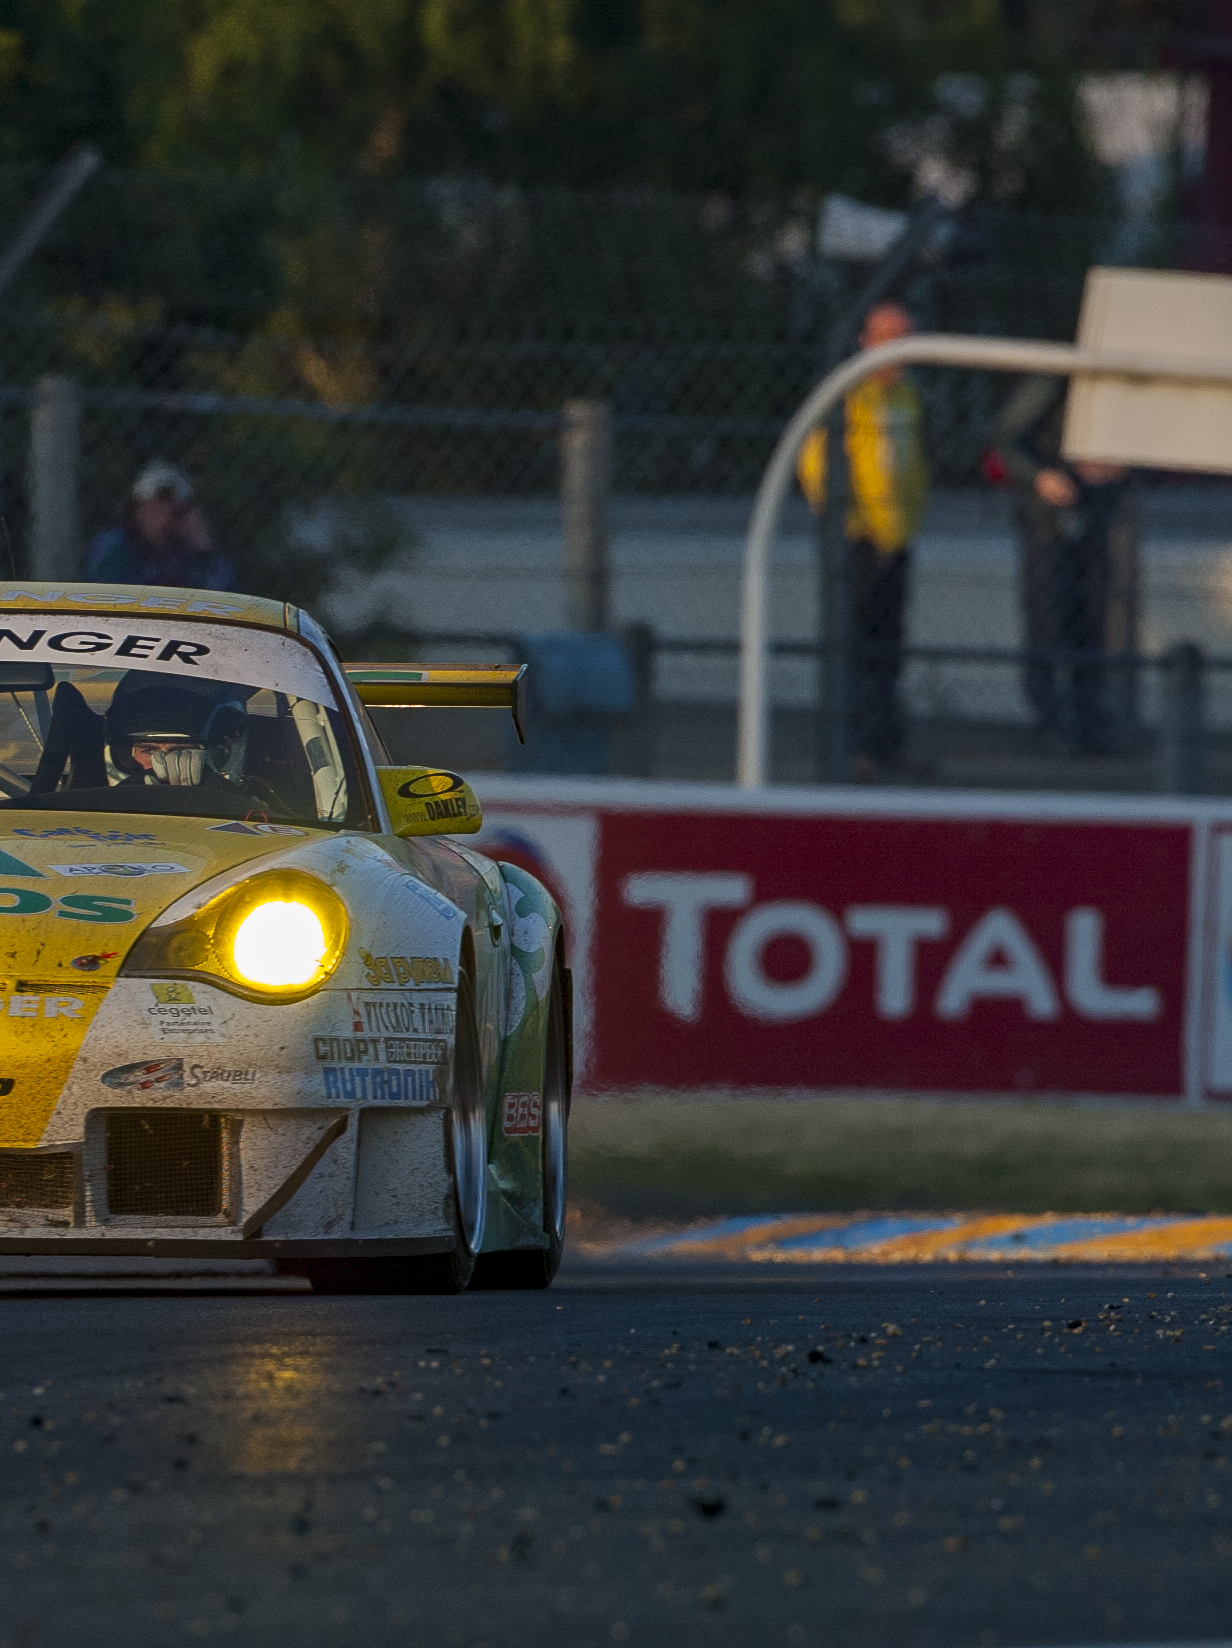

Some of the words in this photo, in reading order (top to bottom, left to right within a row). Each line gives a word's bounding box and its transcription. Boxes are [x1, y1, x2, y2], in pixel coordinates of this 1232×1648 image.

[622, 871, 1159, 1024] TOTAL
[148, 1006, 214, 1017] cegetel
[503, 1093, 542, 1135] BBS
